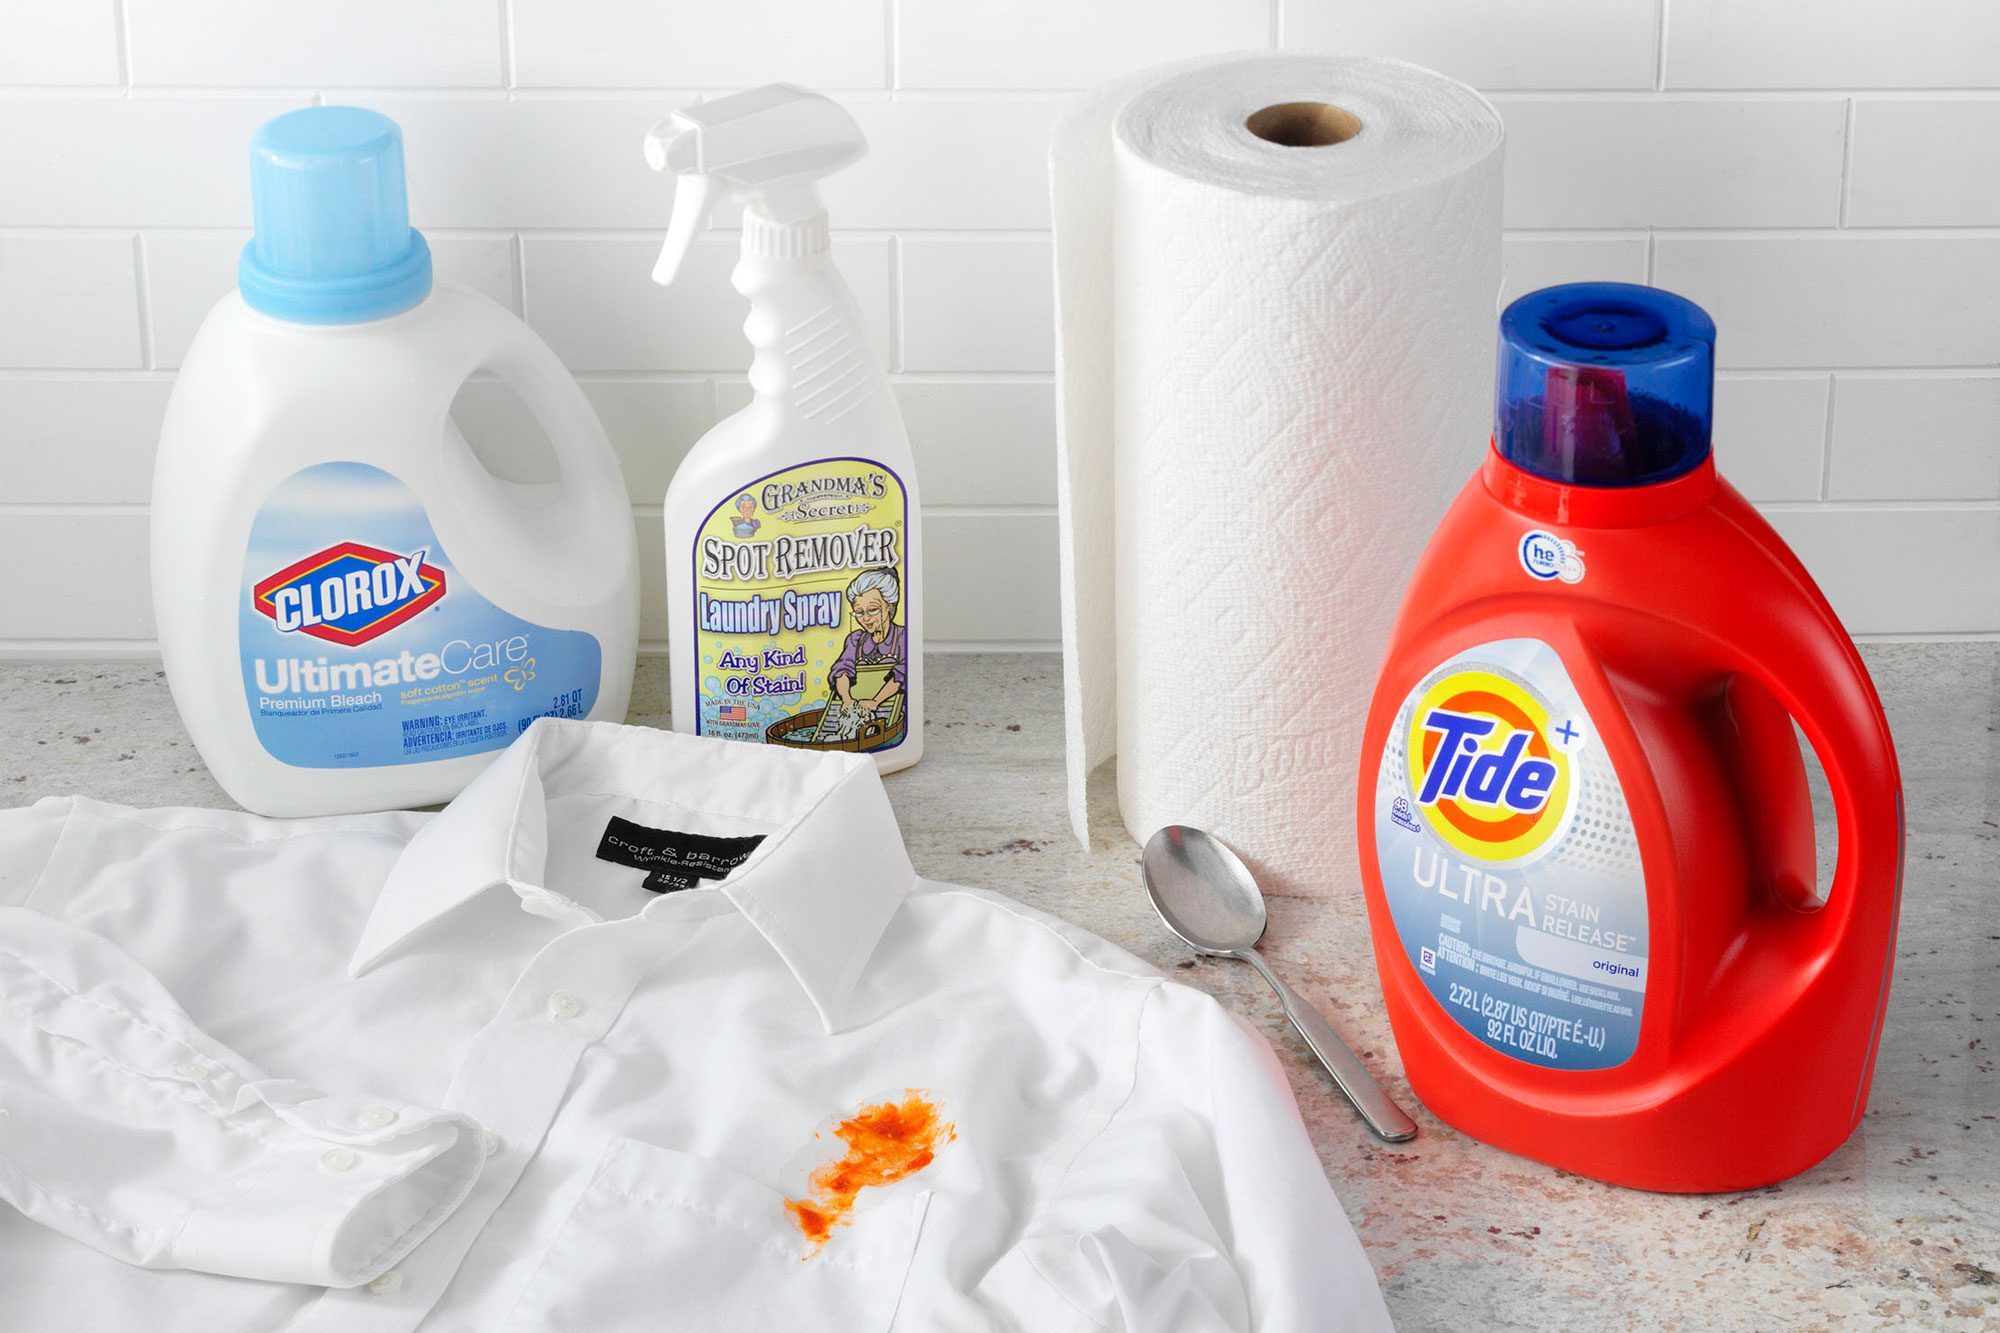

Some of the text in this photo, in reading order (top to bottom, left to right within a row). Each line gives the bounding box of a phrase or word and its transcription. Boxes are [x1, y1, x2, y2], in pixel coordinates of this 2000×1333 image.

[761, 472, 886, 512] GRANDMA'S
[796, 502, 854, 520] Secret
[702, 526, 897, 578] SPOT REMOVER
[1534, 543, 1555, 562] he
[275, 549, 428, 633] CLOROX
[700, 589, 843, 636] Laundry Spray
[719, 646, 807, 673] Any Kind
[400, 687, 423, 699] soft
[467, 674, 498, 687] scent
[726, 673, 805, 695] Of Stain!
[259, 696, 326, 710] Premium
[330, 691, 382, 708] Bleach
[553, 688, 583, 709] 2.81 QT
[578, 702, 584, 714] L
[260, 703, 382, 718] Blanqueador de Primera Calidad
[402, 717, 443, 732] WARNING:
[444, 715, 456, 726] EYE
[403, 731, 454, 748] ADVERTENCIA:
[455, 727, 483, 739] IRRITANTE
[485, 725, 493, 734] DE
[1421, 708, 1557, 807] Tide
[1393, 796, 1409, 813] 48
[607, 835, 654, 855] croft
[662, 847, 678, 858] &
[1413, 846, 1536, 928] ULTRA
[1544, 893, 1600, 923] STAIN
[1592, 960, 1640, 978] original
[1449, 982, 1472, 1010] 2.72
[1472, 991, 1480, 1013] L
[1482, 993, 1510, 1022] (2.87
[1510, 1004, 1527, 1028] US
[1529, 1011, 1572, 1042] QT/PTE
[1487, 1019, 1558, 1060] 92 FL OZ LIQ.
